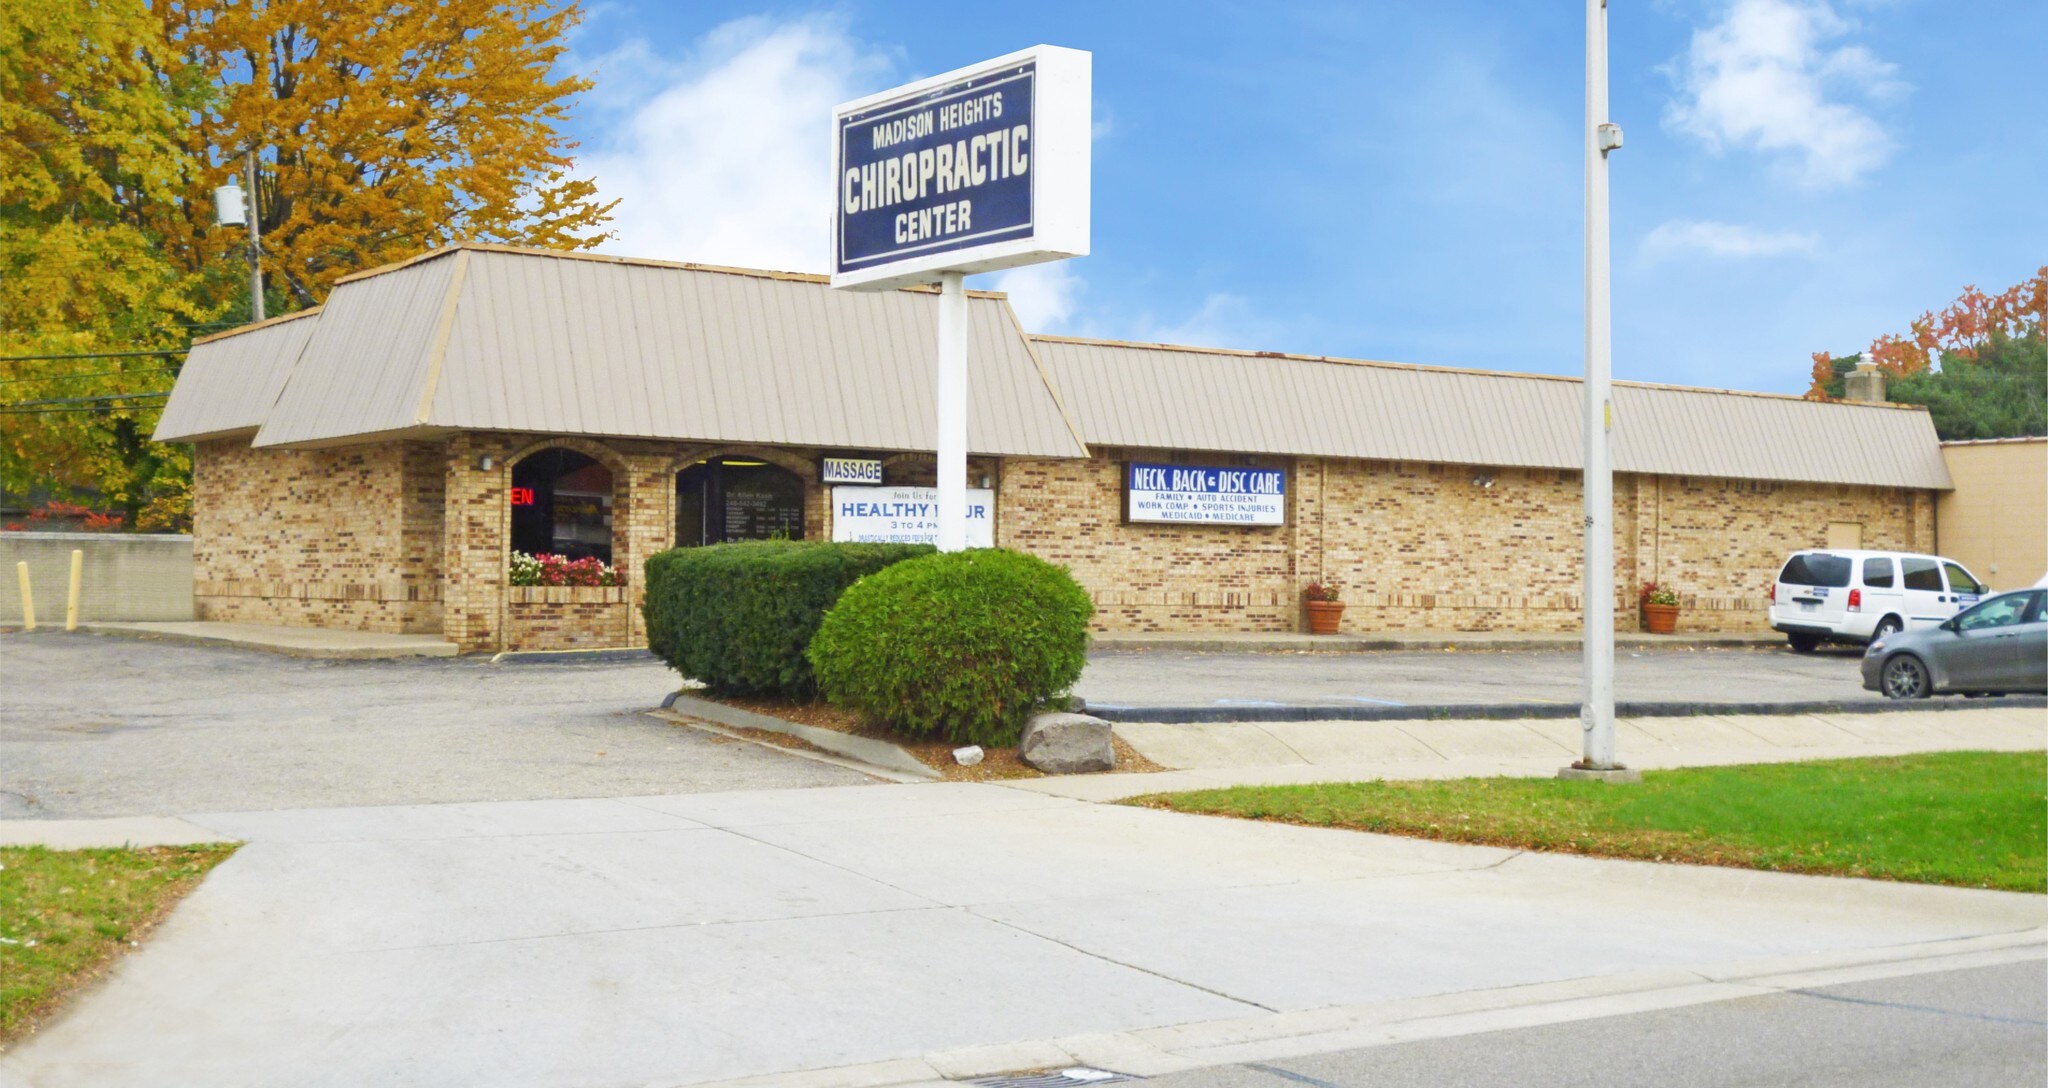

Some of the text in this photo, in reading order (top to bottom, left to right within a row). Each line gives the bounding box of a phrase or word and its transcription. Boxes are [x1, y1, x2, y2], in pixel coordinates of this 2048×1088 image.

[873, 92, 1003, 149] MADISON HEIGHTS
[845, 124, 1028, 215] CHIROPRACTIC
[895, 200, 972, 244] CENTER
[825, 461, 880, 479] MASSAGE
[1173, 470, 1206, 491] BACK
[1208, 476, 1216, 487] &
[1219, 471, 1247, 493] DISC
[1251, 472, 1280, 494] CARE
[892, 491, 937, 501] Join Us for
[1196, 494, 1217, 502] AUTO
[1220, 495, 1257, 503] ACCIDENT
[842, 502, 985, 519] HEALTHY UR
[1138, 501, 1276, 513] WORK COMP SPORTS INJURIES
[1161, 511, 1256, 521] MEDICAID MEDICARE
[891, 521, 898, 529] 3
[917, 521, 923, 529] 4
